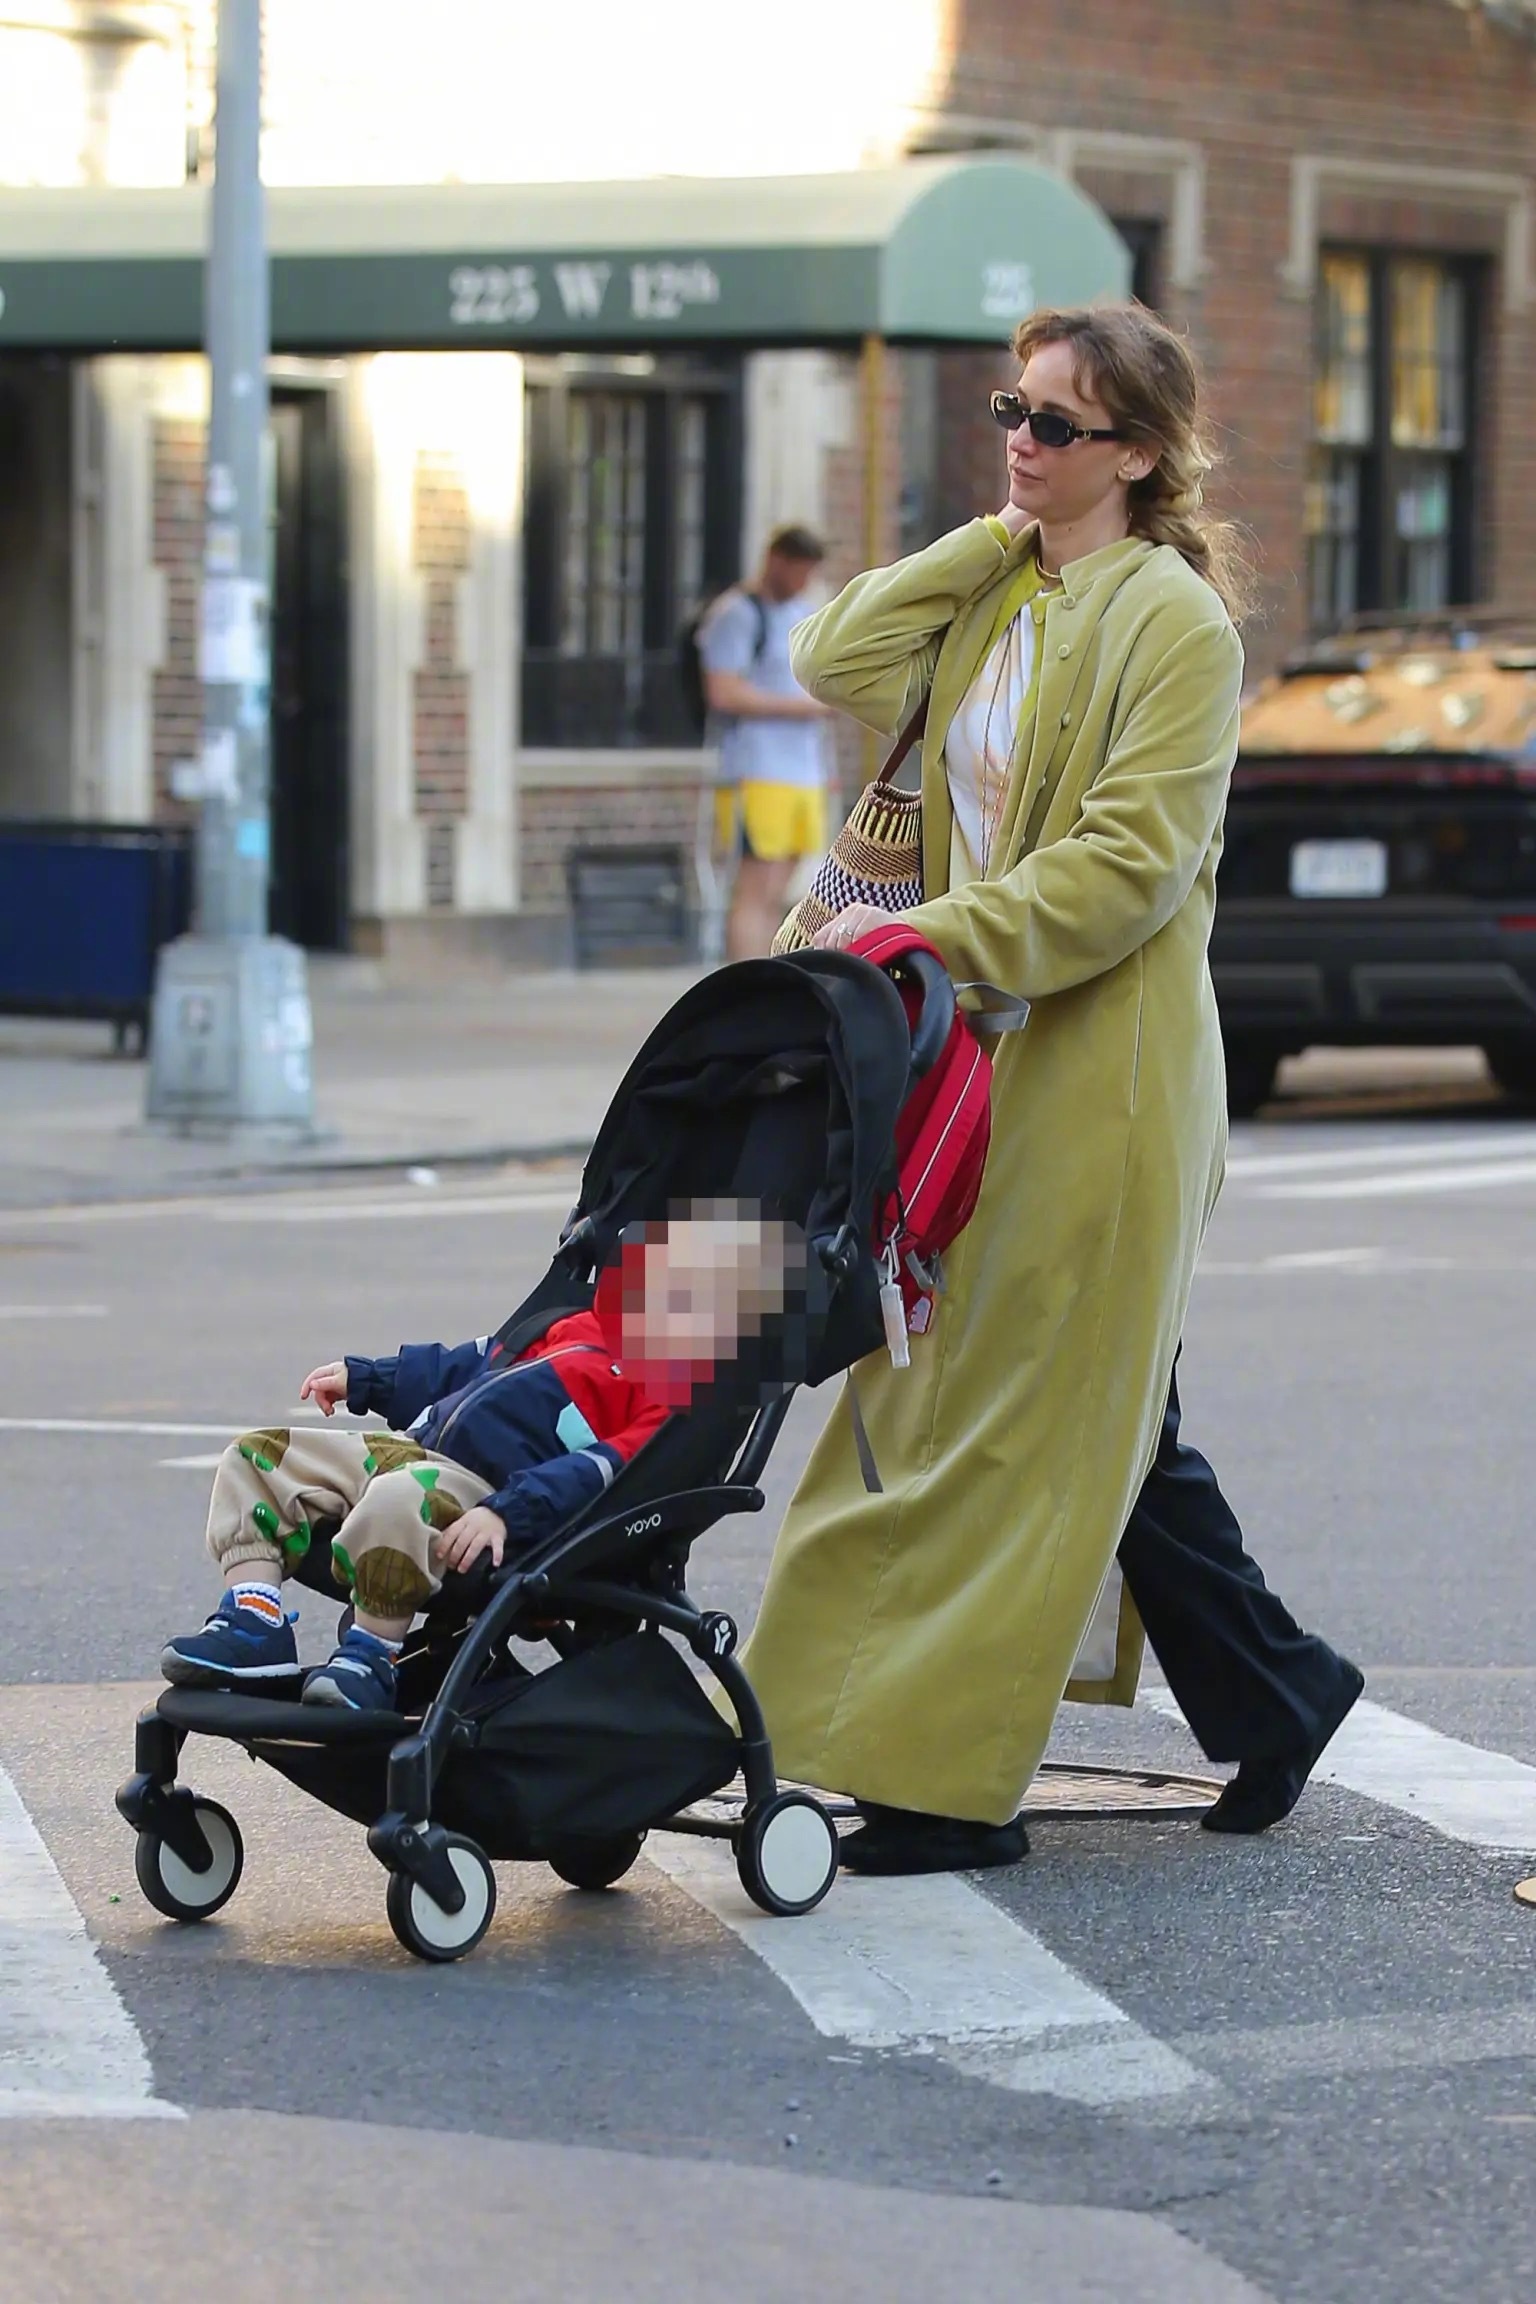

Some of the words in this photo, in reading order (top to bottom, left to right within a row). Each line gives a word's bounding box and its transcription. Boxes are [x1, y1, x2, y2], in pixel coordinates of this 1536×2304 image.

[450, 264, 539, 324] 225
[553, 260, 612, 321] W
[625, 1513, 661, 1536] YOYO
